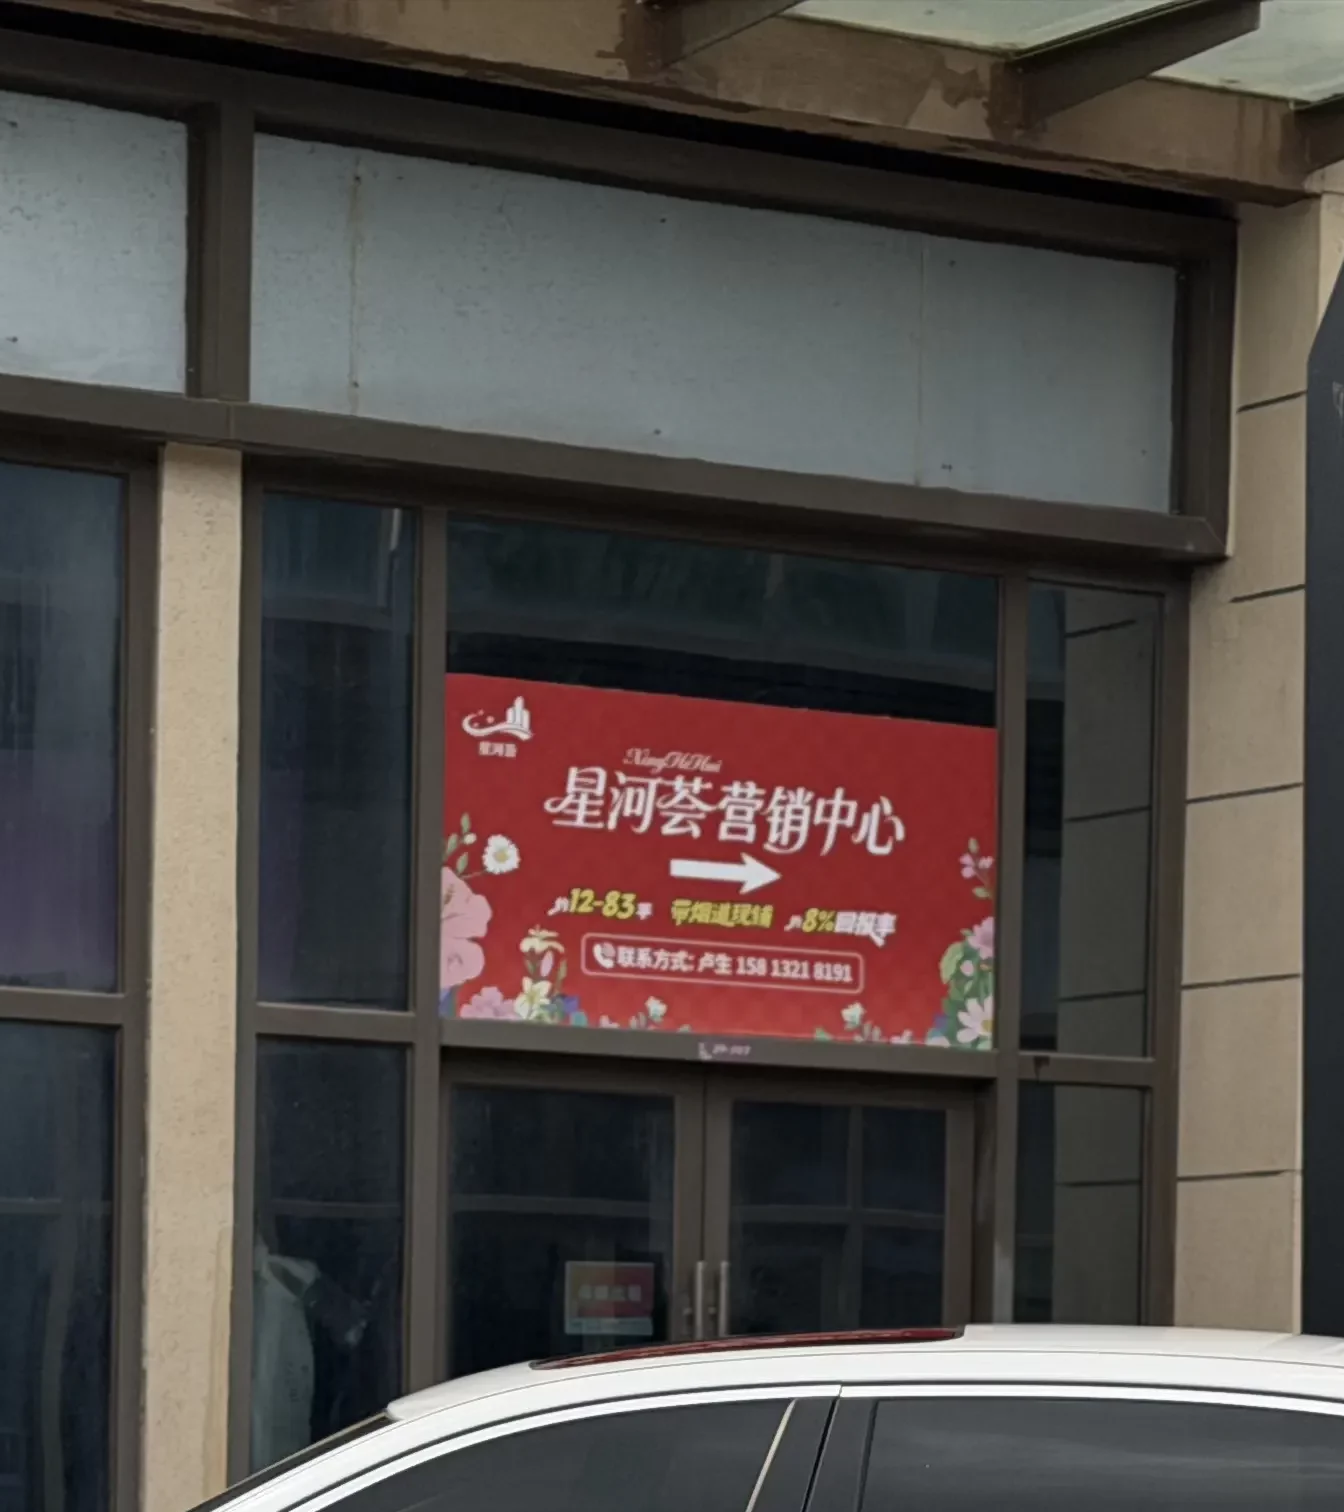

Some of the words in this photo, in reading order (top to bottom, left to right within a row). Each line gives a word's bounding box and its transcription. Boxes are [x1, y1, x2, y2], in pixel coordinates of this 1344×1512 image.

[542, 766, 906, 857] 星河荟营销中心
